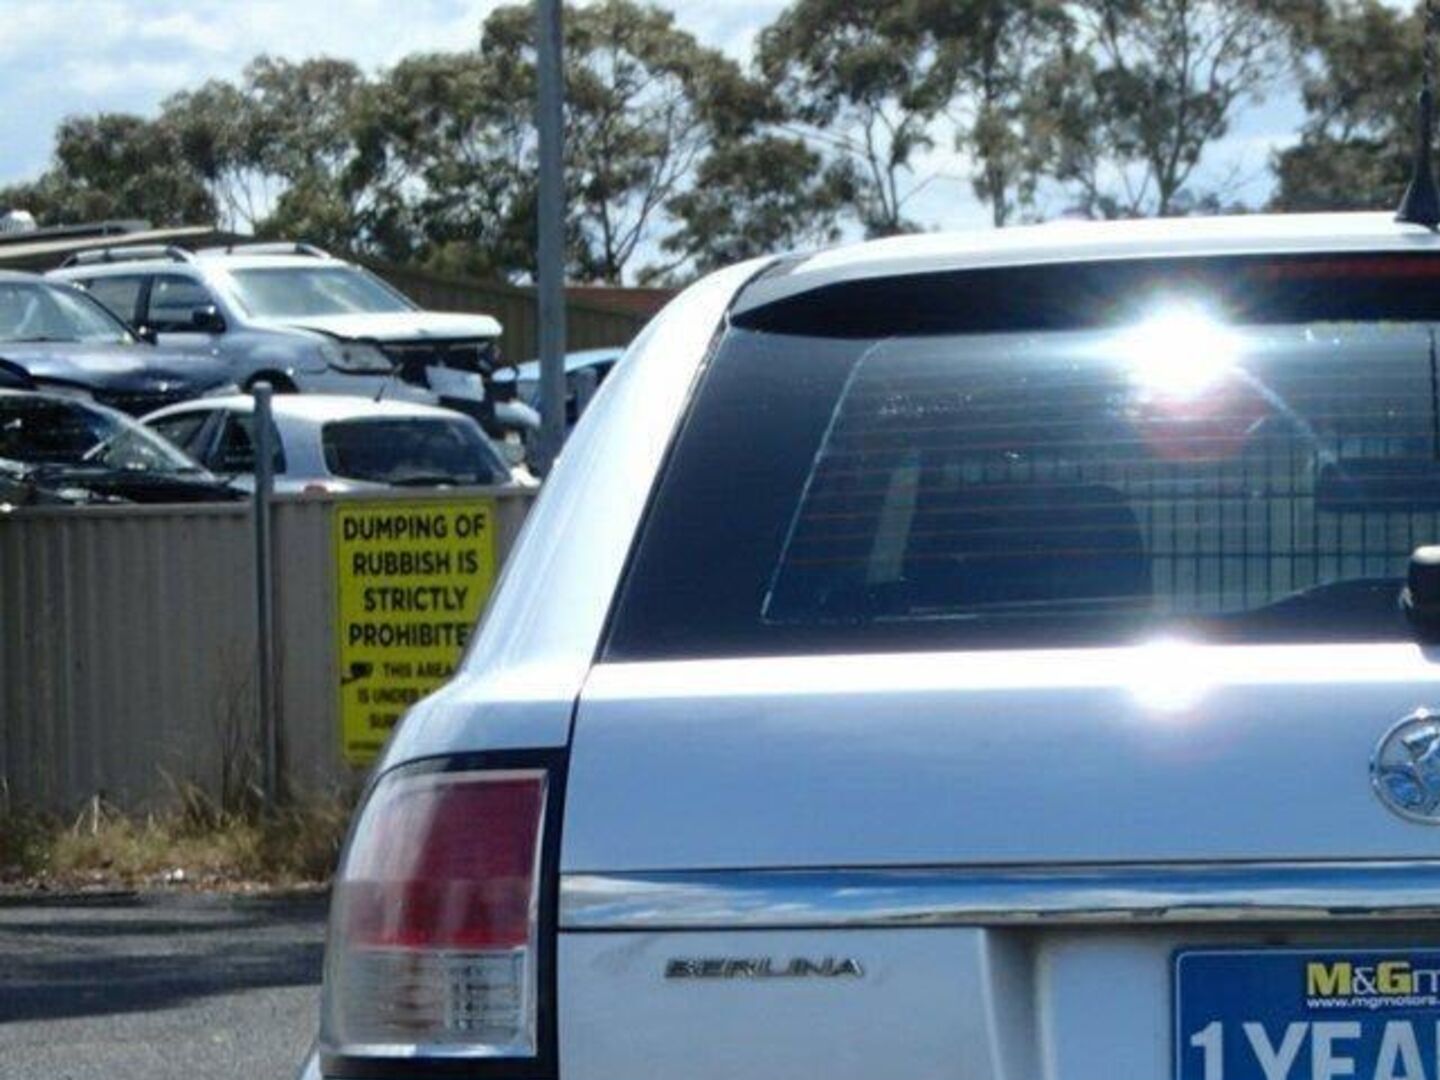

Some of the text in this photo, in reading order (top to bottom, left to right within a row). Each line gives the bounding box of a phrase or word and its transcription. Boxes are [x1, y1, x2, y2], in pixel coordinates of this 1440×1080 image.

[343, 514, 486, 541] DUMPING OF
[352, 550, 479, 576] RUBBISH IS
[364, 586, 468, 612] STRICTLY
[348, 622, 474, 647] PROHIBITE
[384, 661, 412, 678] THIS
[665, 956, 864, 979] BERLINA
